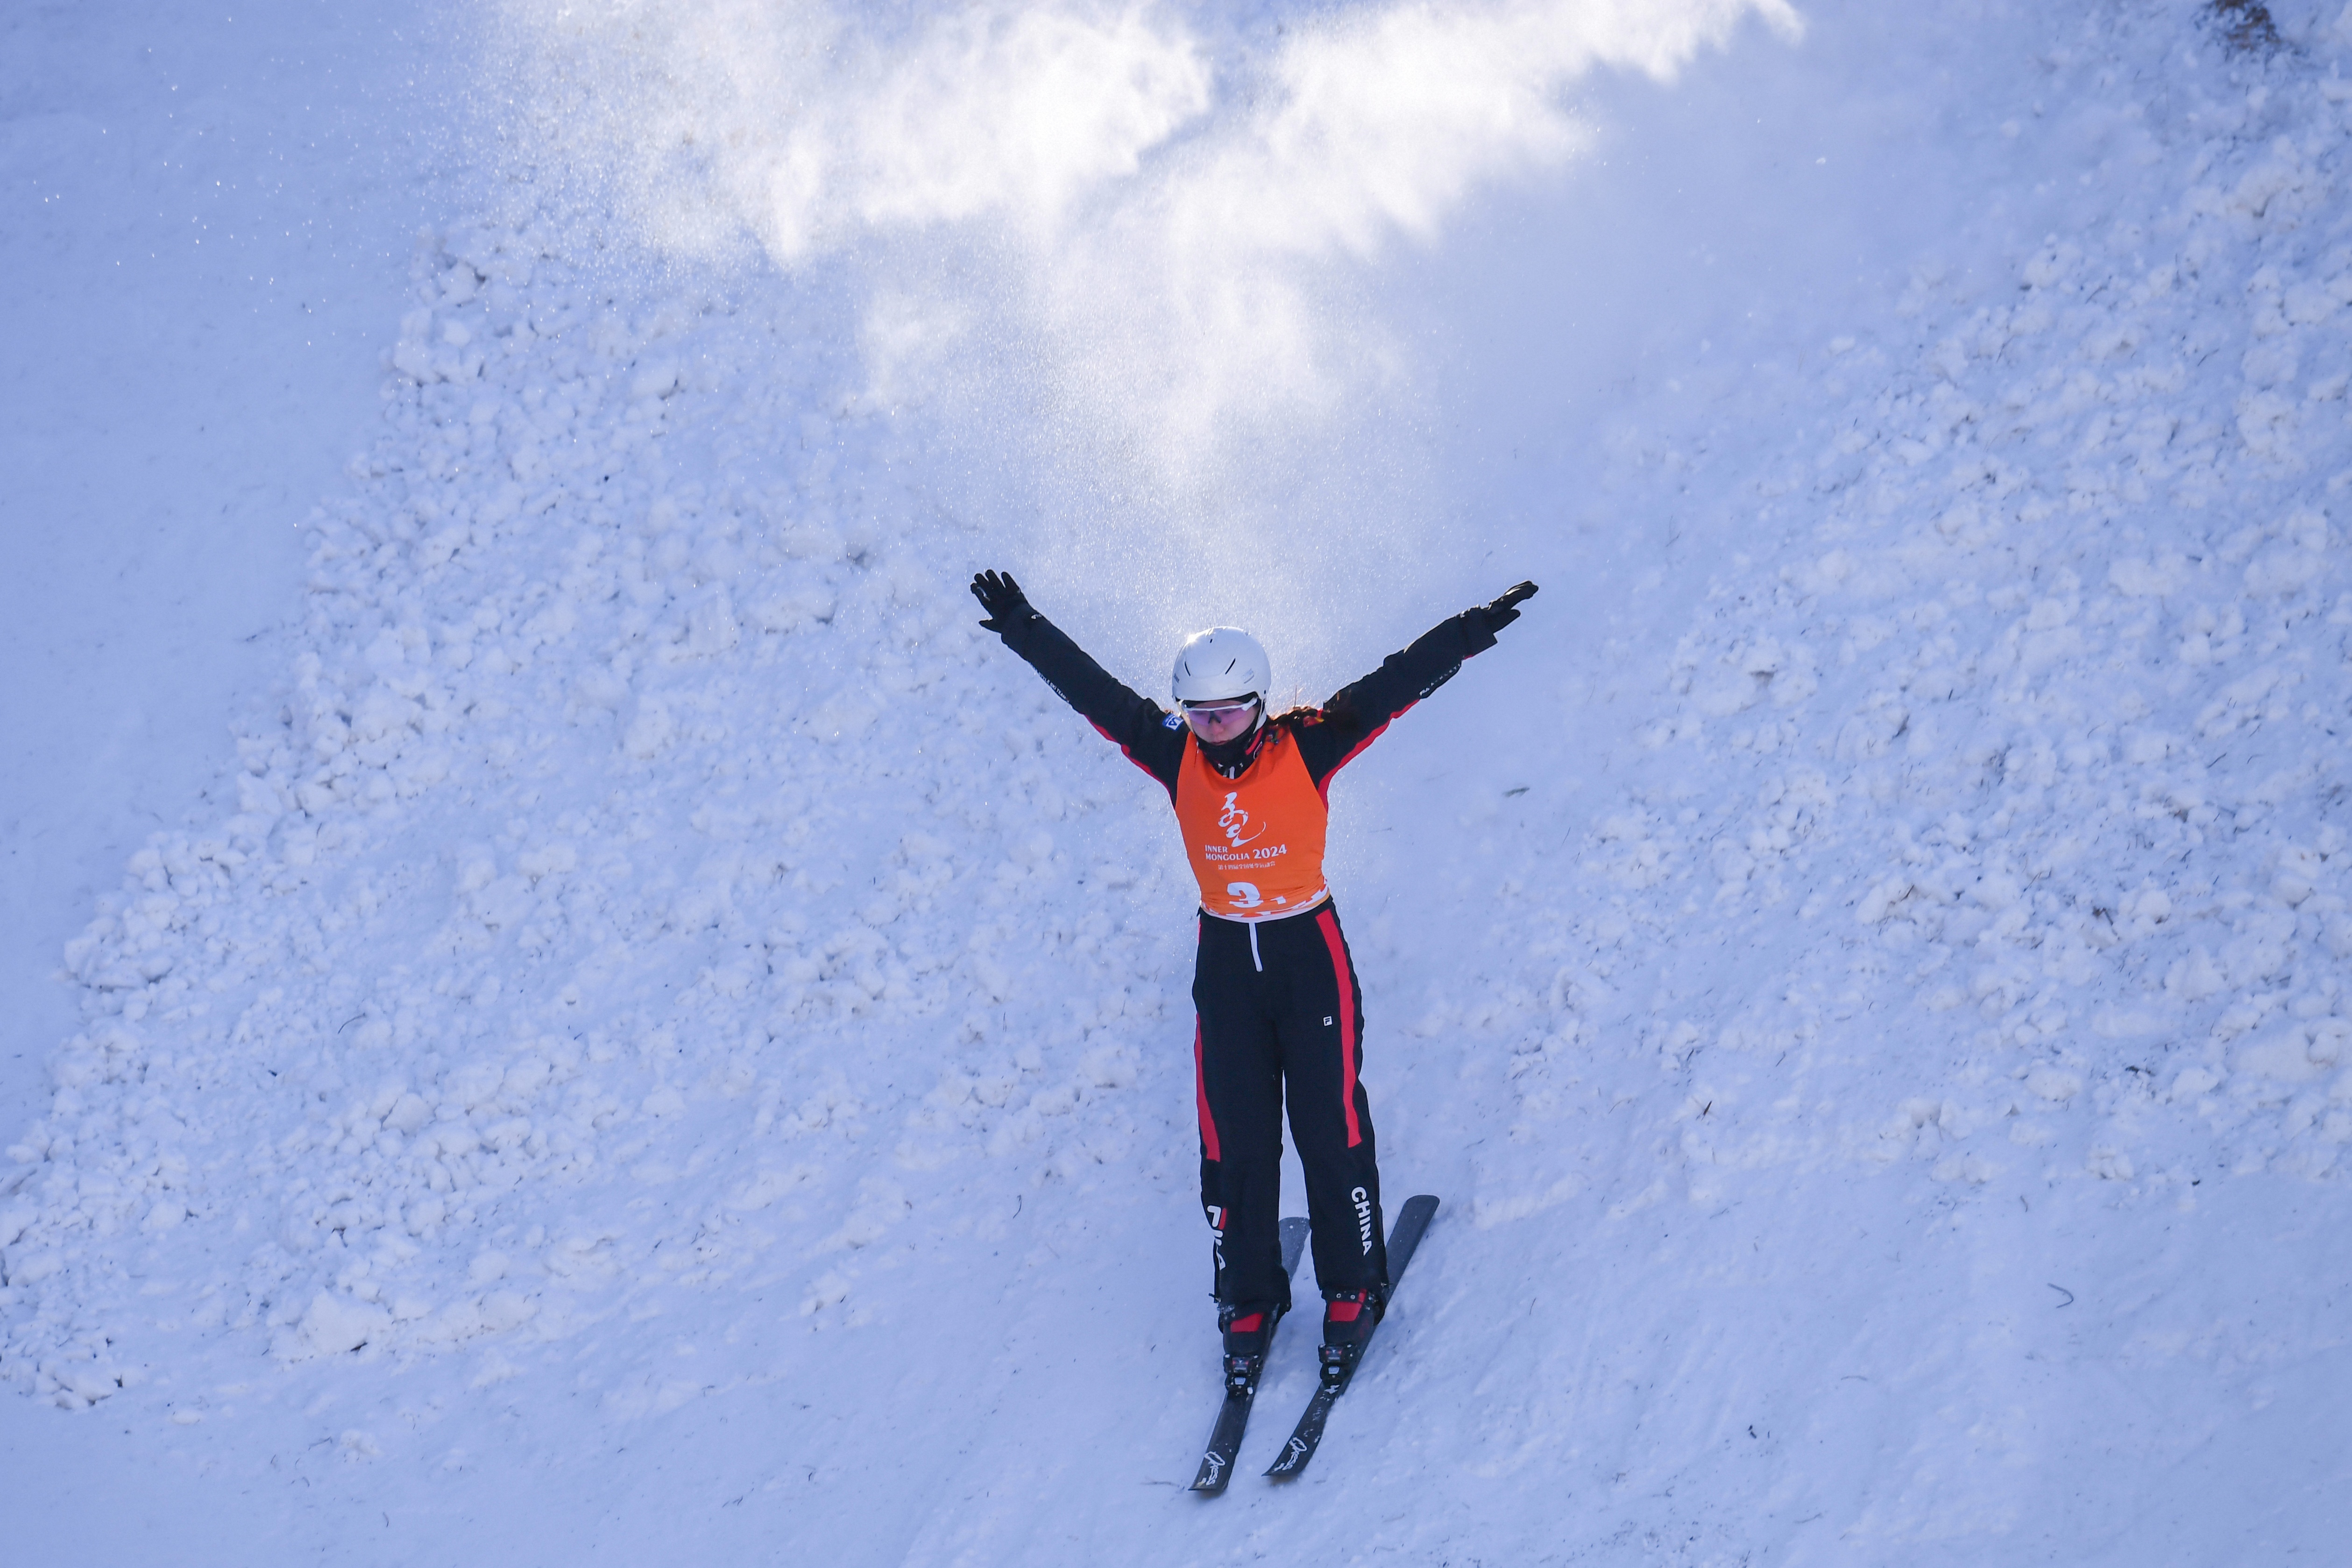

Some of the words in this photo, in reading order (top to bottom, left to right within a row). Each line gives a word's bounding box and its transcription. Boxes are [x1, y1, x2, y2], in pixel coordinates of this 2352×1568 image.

[1204, 844, 1228, 853] INNER
[1205, 852, 1250, 861] MONGOLIA
[1253, 844, 1287, 859] 2024
[1351, 1186, 1372, 1256] CHINA
